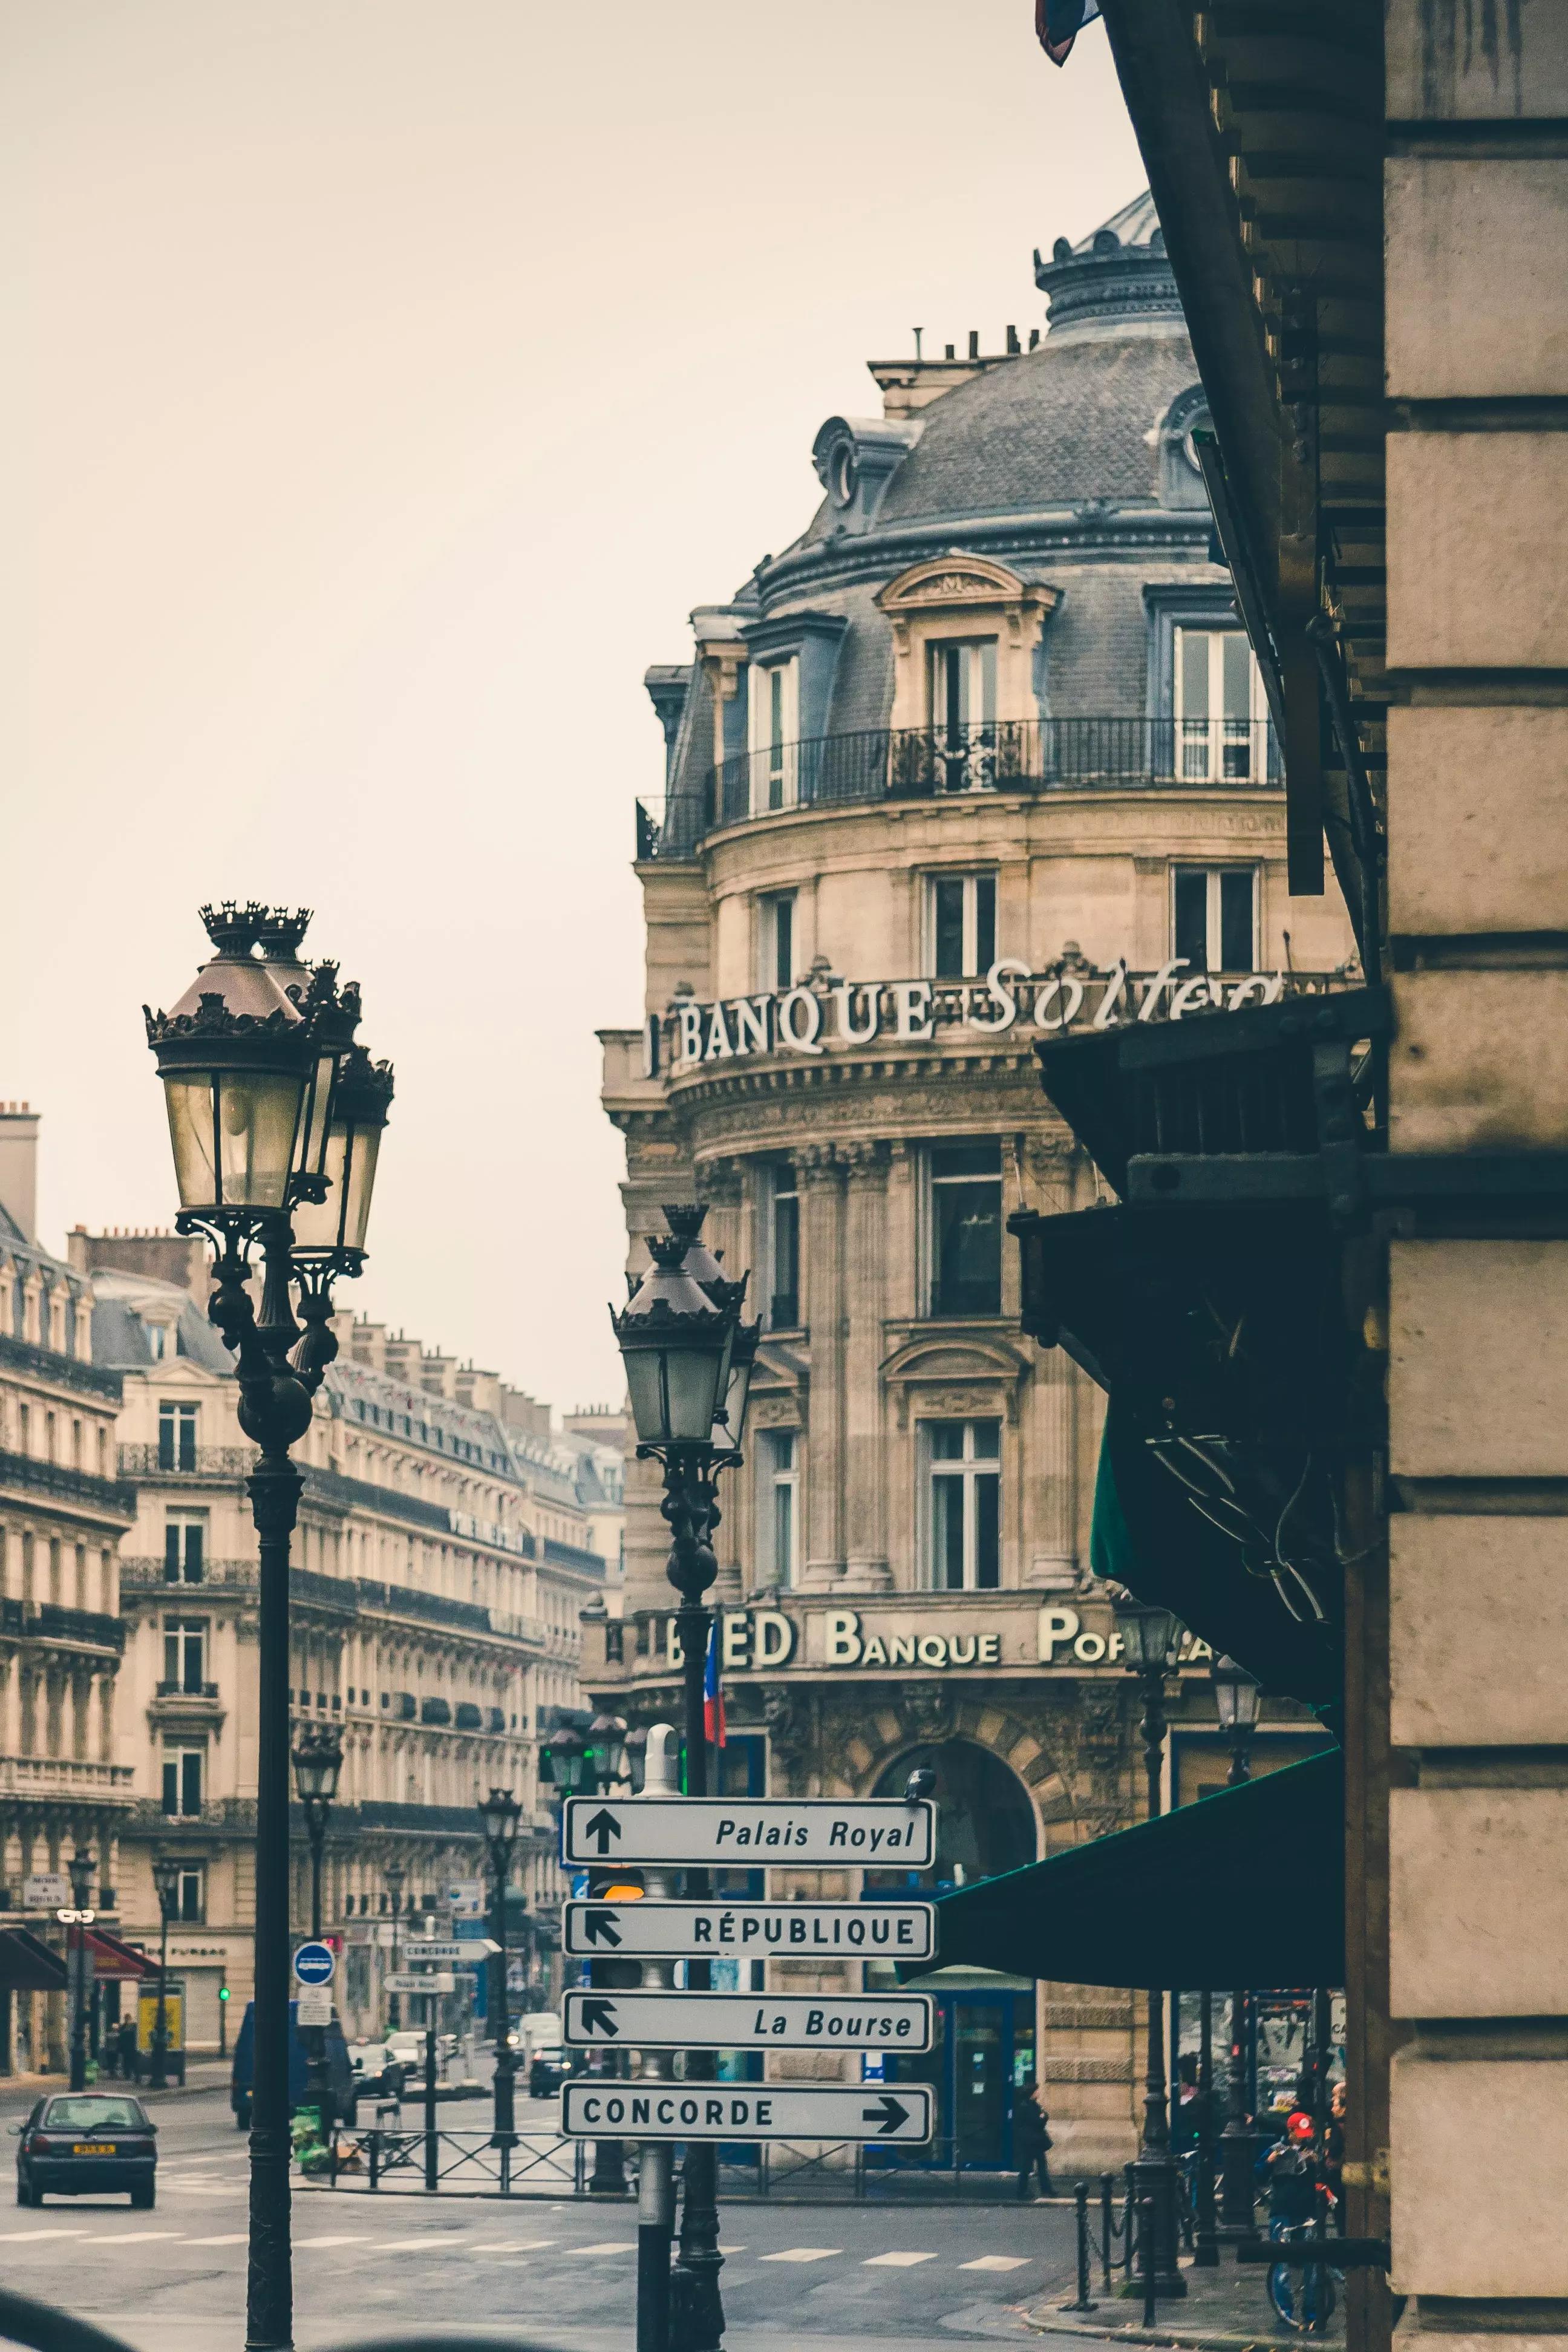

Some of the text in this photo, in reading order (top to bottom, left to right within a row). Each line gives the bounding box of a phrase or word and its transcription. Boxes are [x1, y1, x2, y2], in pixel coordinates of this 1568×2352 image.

[679, 982, 933, 1063] BANQUE
[667, 1612, 792, 1669] BED
[825, 1610, 999, 1667] BANQUE
[716, 1820, 913, 1851] Palais Royal
[694, 1912, 913, 1944] RÉPUBLIQUE
[754, 2009, 911, 2037] La Bourse
[583, 2099, 773, 2125] CONCORDE
